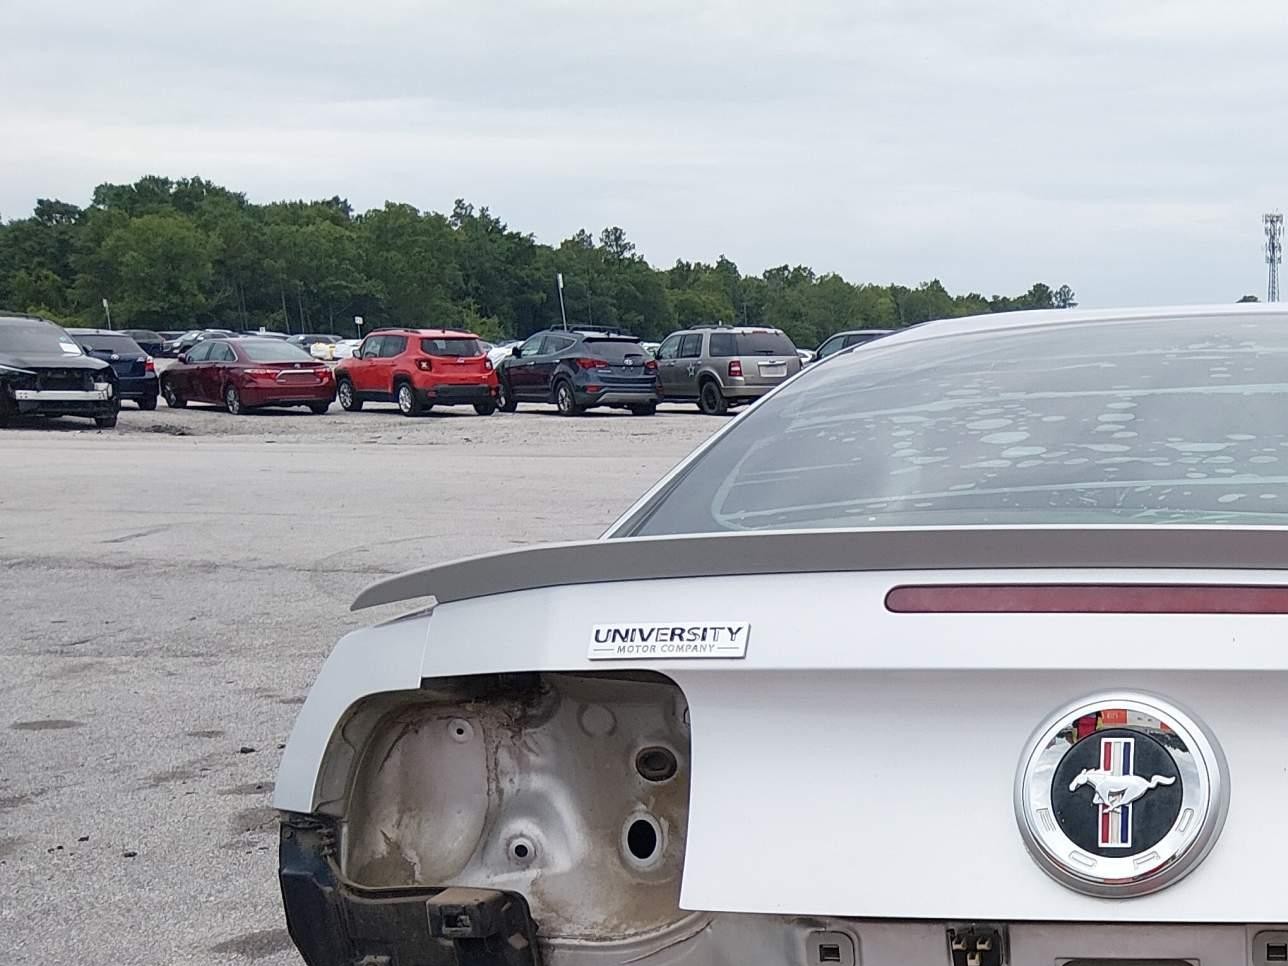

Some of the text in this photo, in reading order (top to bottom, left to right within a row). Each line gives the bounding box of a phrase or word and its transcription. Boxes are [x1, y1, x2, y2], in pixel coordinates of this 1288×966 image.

[594, 627, 743, 643] UNIVERSITY
[616, 644, 716, 654] MOTOR COMPANY
